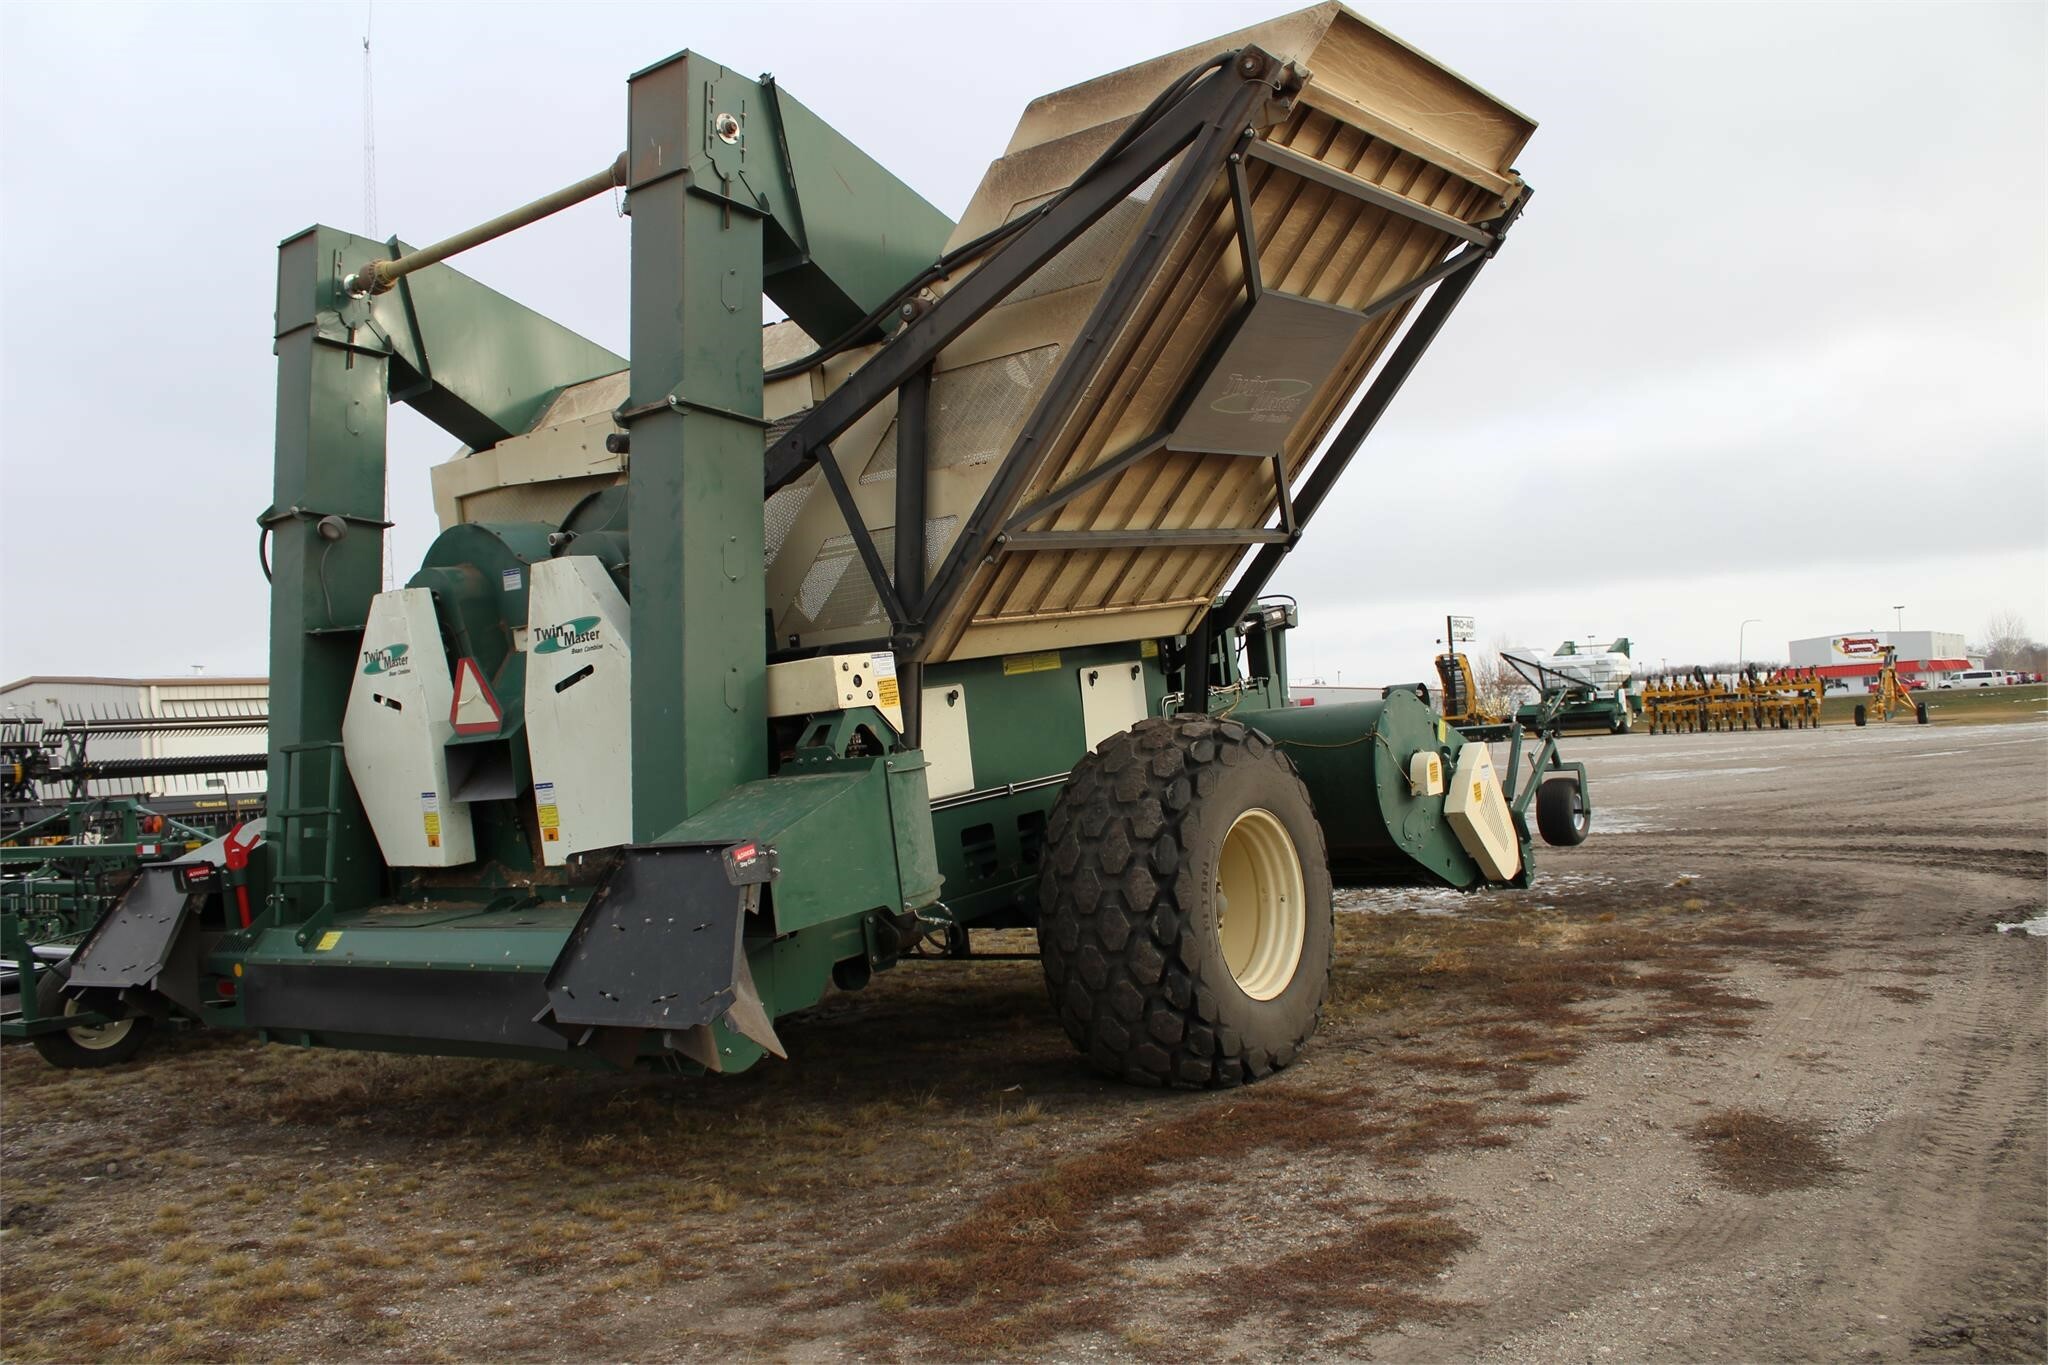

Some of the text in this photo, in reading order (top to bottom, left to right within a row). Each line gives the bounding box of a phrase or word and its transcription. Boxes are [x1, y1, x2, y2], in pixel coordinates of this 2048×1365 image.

[534, 624, 563, 642] Twin
[564, 630, 600, 646] Master
[363, 649, 384, 664] Twin
[384, 656, 408, 670] Master
